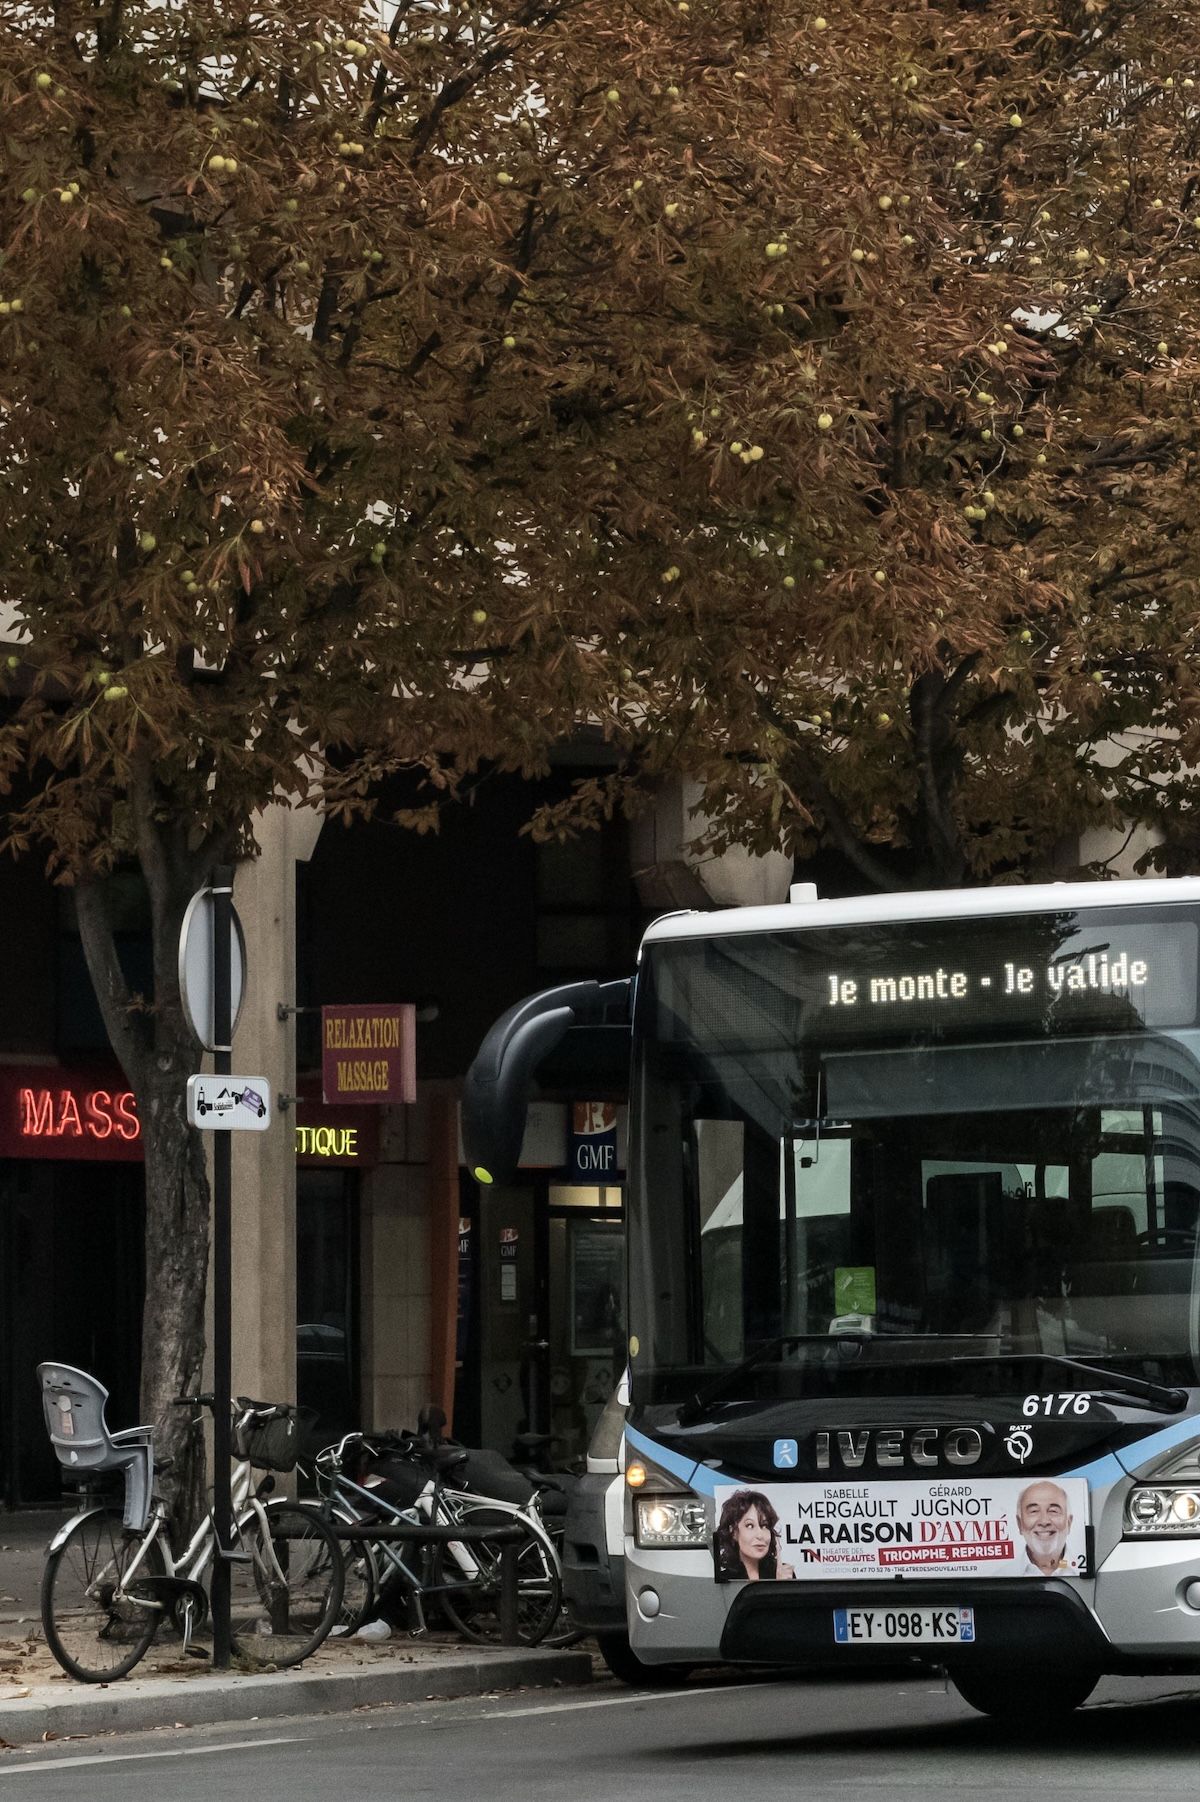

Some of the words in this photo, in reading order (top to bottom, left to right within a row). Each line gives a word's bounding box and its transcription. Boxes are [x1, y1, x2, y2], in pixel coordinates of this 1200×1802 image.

[870, 968, 967, 1003] monte
[1047, 952, 1148, 990] valide
[325, 1017, 400, 1049] RELAXATION
[337, 1060, 389, 1092] MASSAGE
[295, 1126, 359, 1157] TIQUE
[576, 1143, 615, 1170] GMF
[500, 1245, 518, 1258] GMF
[1022, 1393, 1091, 1417] 6176
[1009, 1424, 1033, 1432] RATP
[816, 1428, 982, 1469] IVECO
[824, 1488, 870, 1499] ISABELLE
[929, 1484, 972, 1497] GÉRARD
[798, 1500, 898, 1519] MERGAULT
[911, 1498, 992, 1517] JUGNOT
[785, 1523, 816, 1544] LA
[819, 1522, 913, 1544] RAISON
[800, 1548, 821, 1563] TN
[883, 1547, 950, 1562] TRIOMPHE,
[952, 1545, 1002, 1558] REPRISE
[961, 1624, 972, 1637] 75
